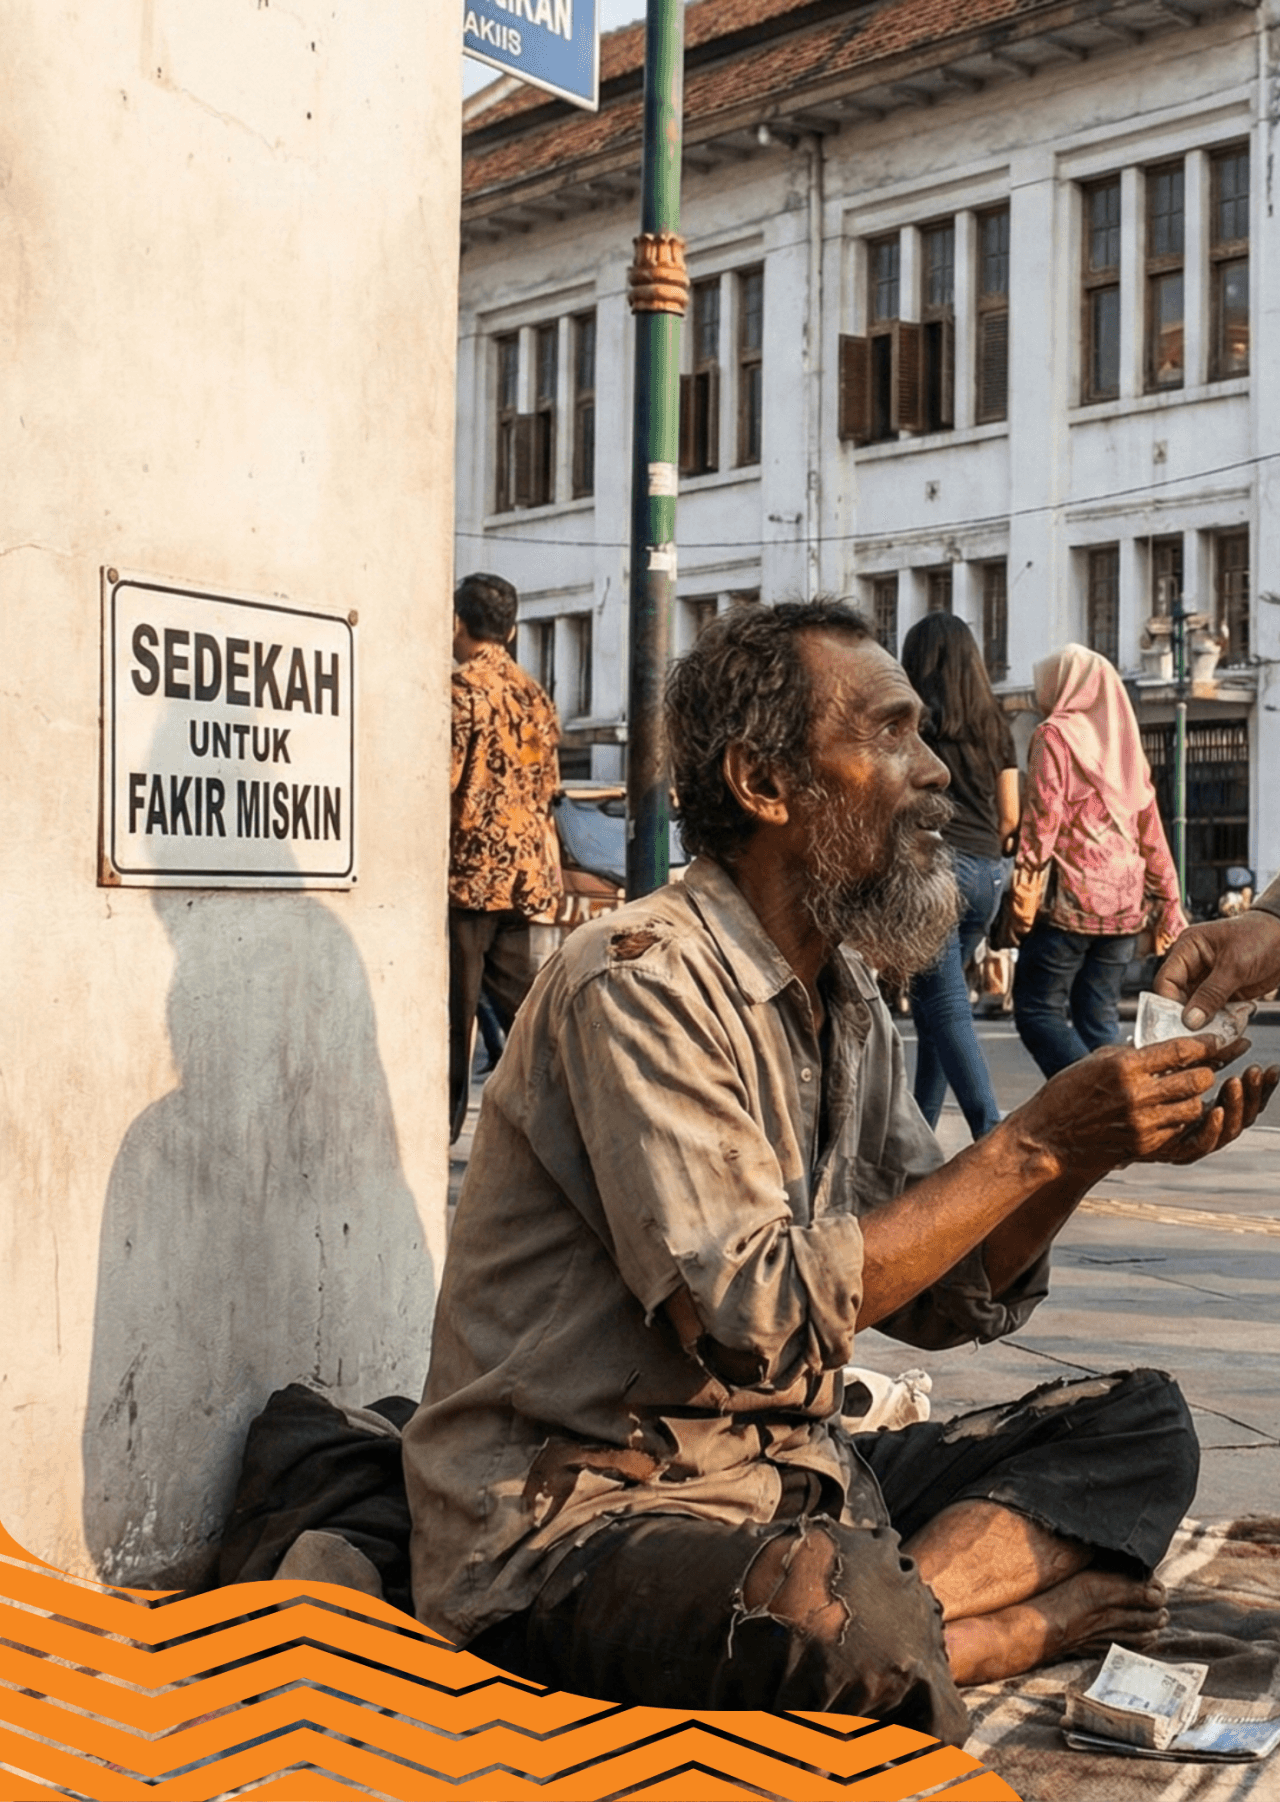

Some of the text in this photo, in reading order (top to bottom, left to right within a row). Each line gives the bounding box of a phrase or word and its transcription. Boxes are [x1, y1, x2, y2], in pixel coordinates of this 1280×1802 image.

[130, 623, 339, 717] SEDEKAH
[189, 719, 292, 764] UNTUK
[128, 772, 342, 841] FAKIR MISKIN
